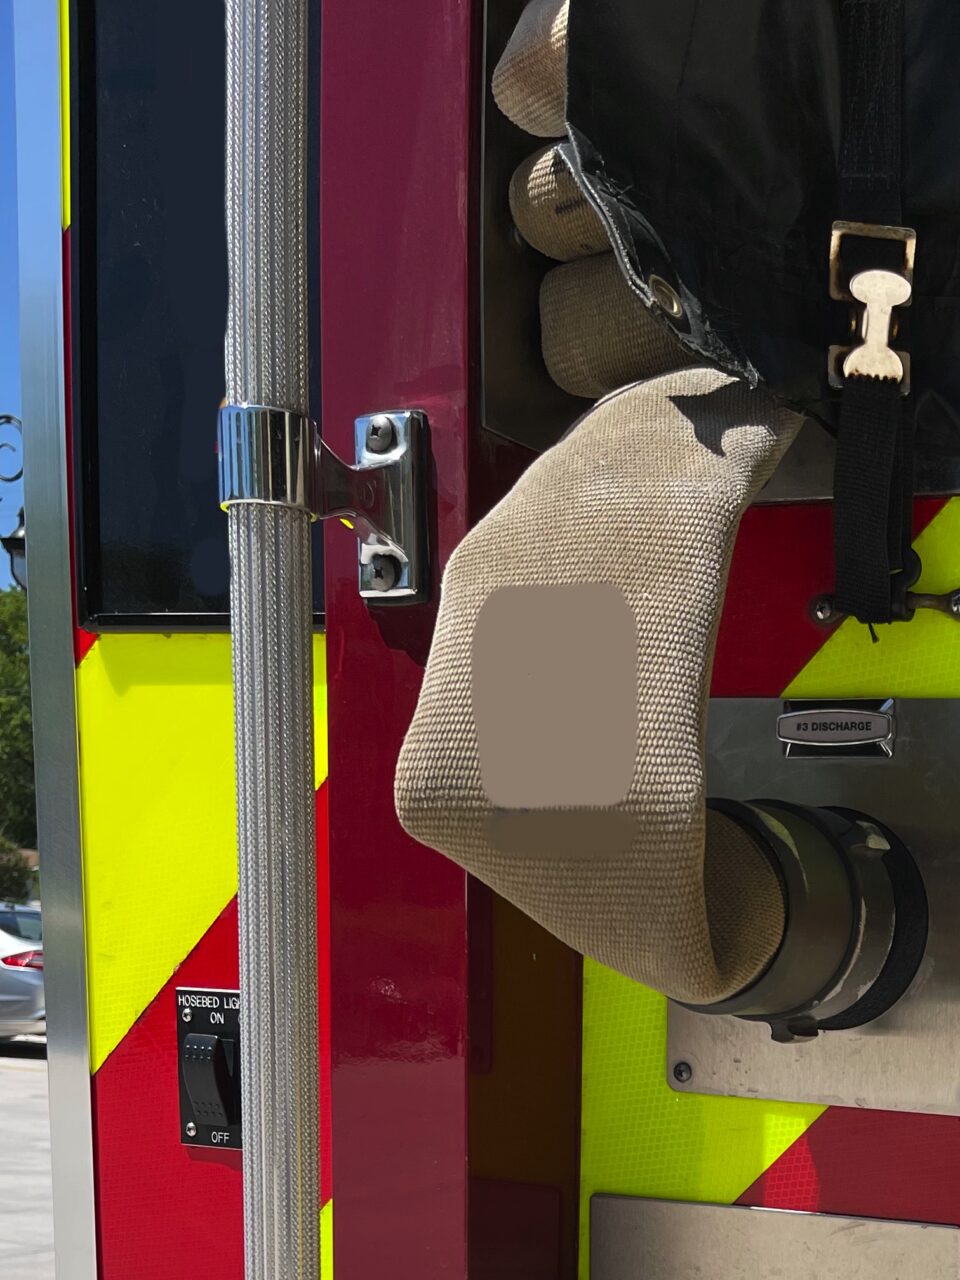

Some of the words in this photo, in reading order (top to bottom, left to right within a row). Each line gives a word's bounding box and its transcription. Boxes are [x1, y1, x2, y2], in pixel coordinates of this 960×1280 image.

[796, 722, 809, 732] #3
[811, 721, 872, 732] DISCHARGE
[177, 994, 220, 1009] HOSEBED
[210, 1011, 225, 1025] ON
[211, 1131, 230, 1144] OFF
